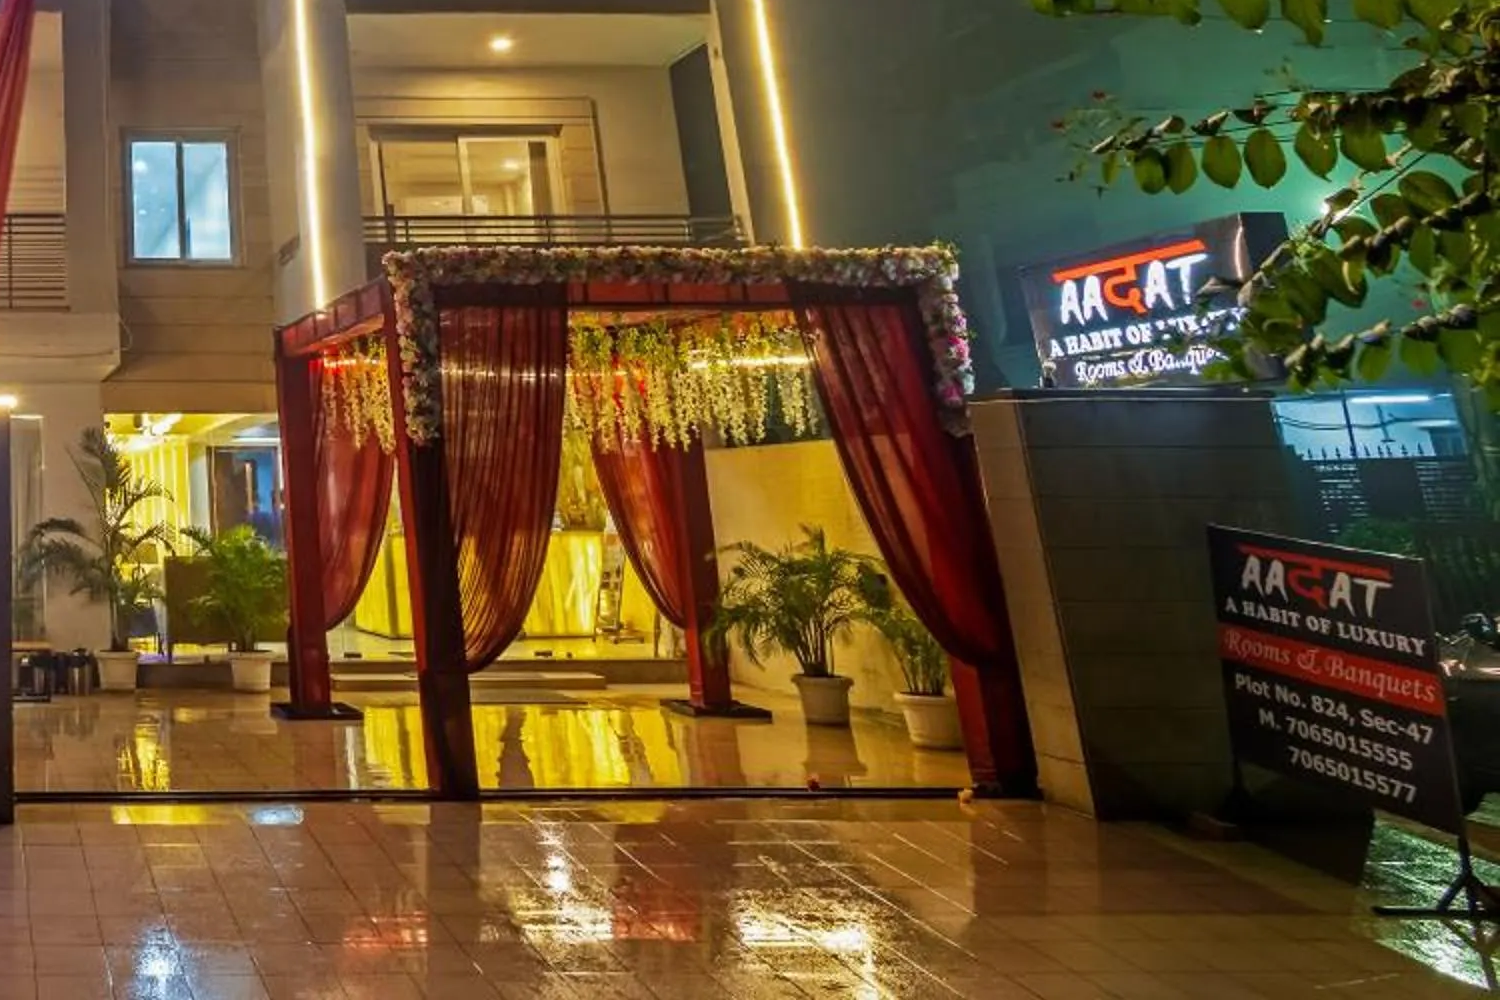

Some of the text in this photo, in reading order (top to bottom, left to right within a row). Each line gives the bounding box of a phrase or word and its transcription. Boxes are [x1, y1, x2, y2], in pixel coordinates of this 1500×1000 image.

[1050, 338, 1064, 358] A
[1065, 327, 1124, 355] HABIT
[1125, 321, 1152, 344] OF
[1075, 360, 1125, 382] Rooms
[1225, 596, 1426, 656] A HABIT OF LUXURY
[1225, 629, 1291, 665] Rooms
[1325, 654, 1436, 703] Banquets
[1235, 673, 1434, 745] Plot No. 824, Sec-47
[1258, 708, 1414, 771] M. 7065015555
[1288, 746, 1417, 803] 7065015577
